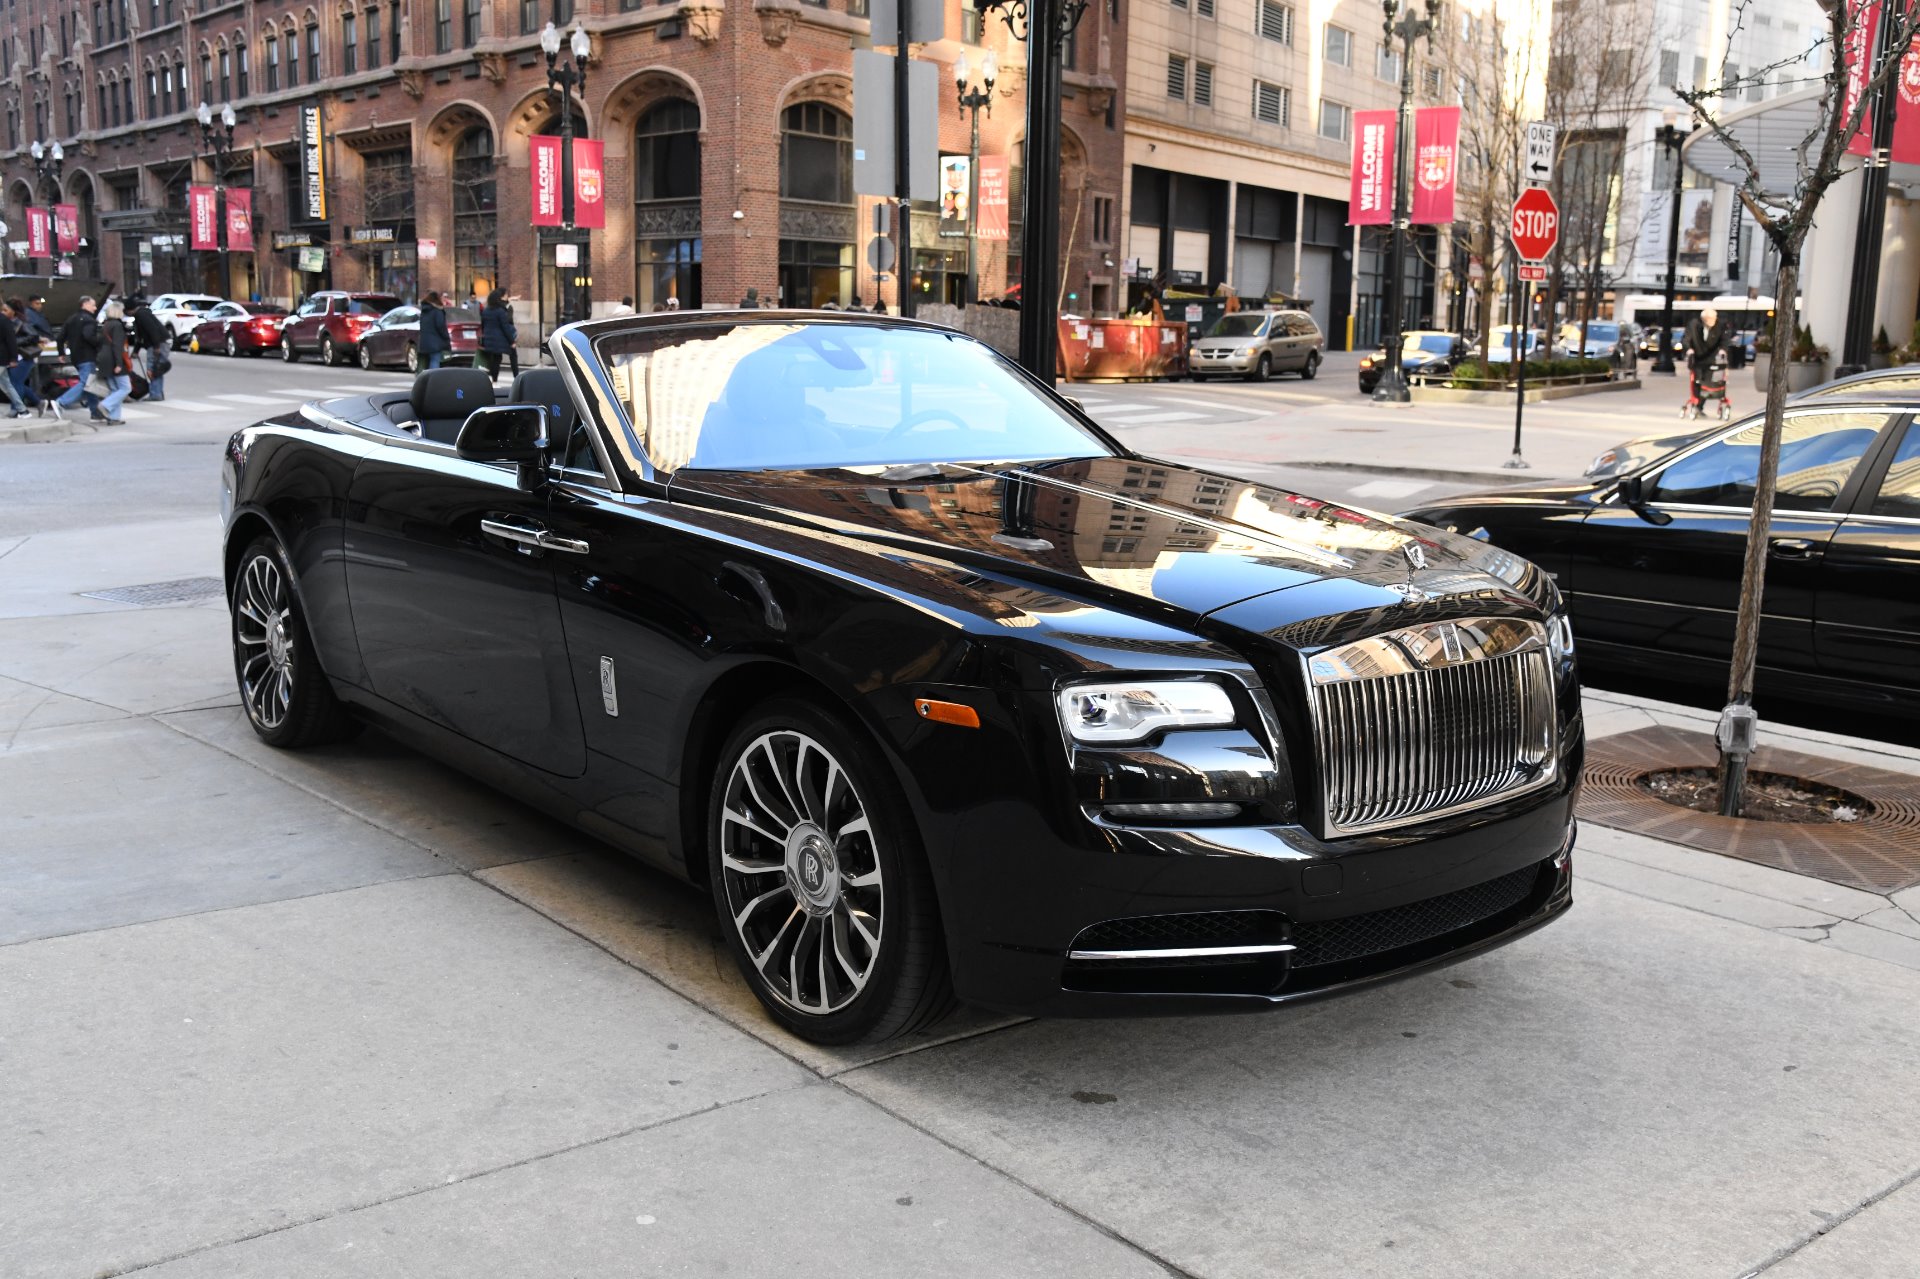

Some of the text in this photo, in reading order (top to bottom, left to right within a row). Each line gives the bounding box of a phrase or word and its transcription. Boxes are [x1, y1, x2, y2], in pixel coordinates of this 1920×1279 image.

[1420, 145, 1452, 154] LOYOLA
[1529, 143, 1551, 158] WAY
[1530, 126, 1552, 143] ONE
[305, 108, 321, 218] EINSTEIN BROS. BAGELS
[538, 146, 550, 215] WELCOME
[1360, 124, 1377, 211] WELCOME
[1374, 124, 1385, 211] WATER TOWER CAMPUS
[196, 194, 206, 242] WELCOME
[1513, 209, 1556, 239] STOP
[1521, 268, 1544, 278] ALL WAY
